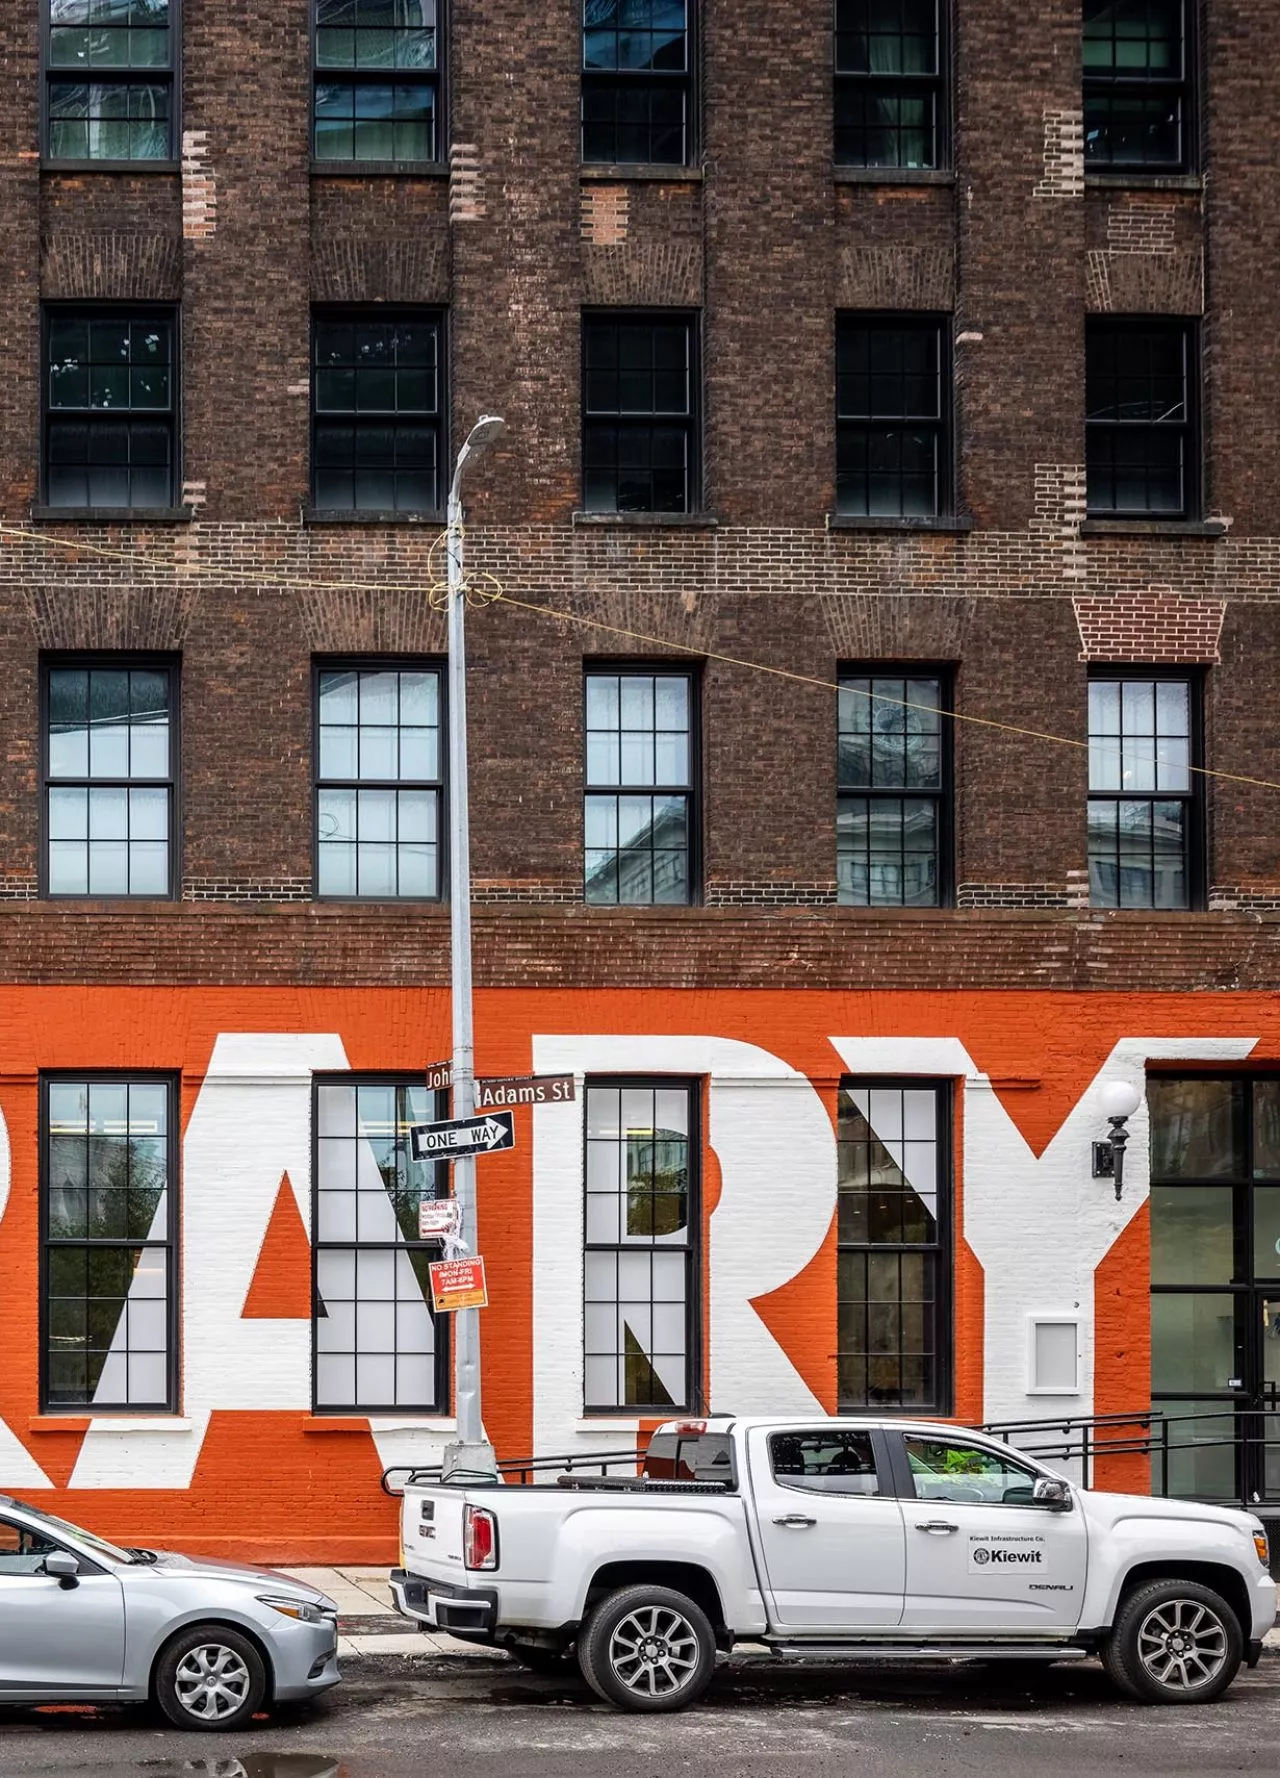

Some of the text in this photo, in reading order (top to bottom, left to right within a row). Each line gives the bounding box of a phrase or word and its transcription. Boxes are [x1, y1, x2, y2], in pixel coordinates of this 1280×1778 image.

[482, 1081, 571, 1107] Adams St
[426, 1125, 499, 1149] ONE WAY
[431, 1258, 481, 1272] NO STANDING
[991, 1549, 1043, 1563] Kiewit
